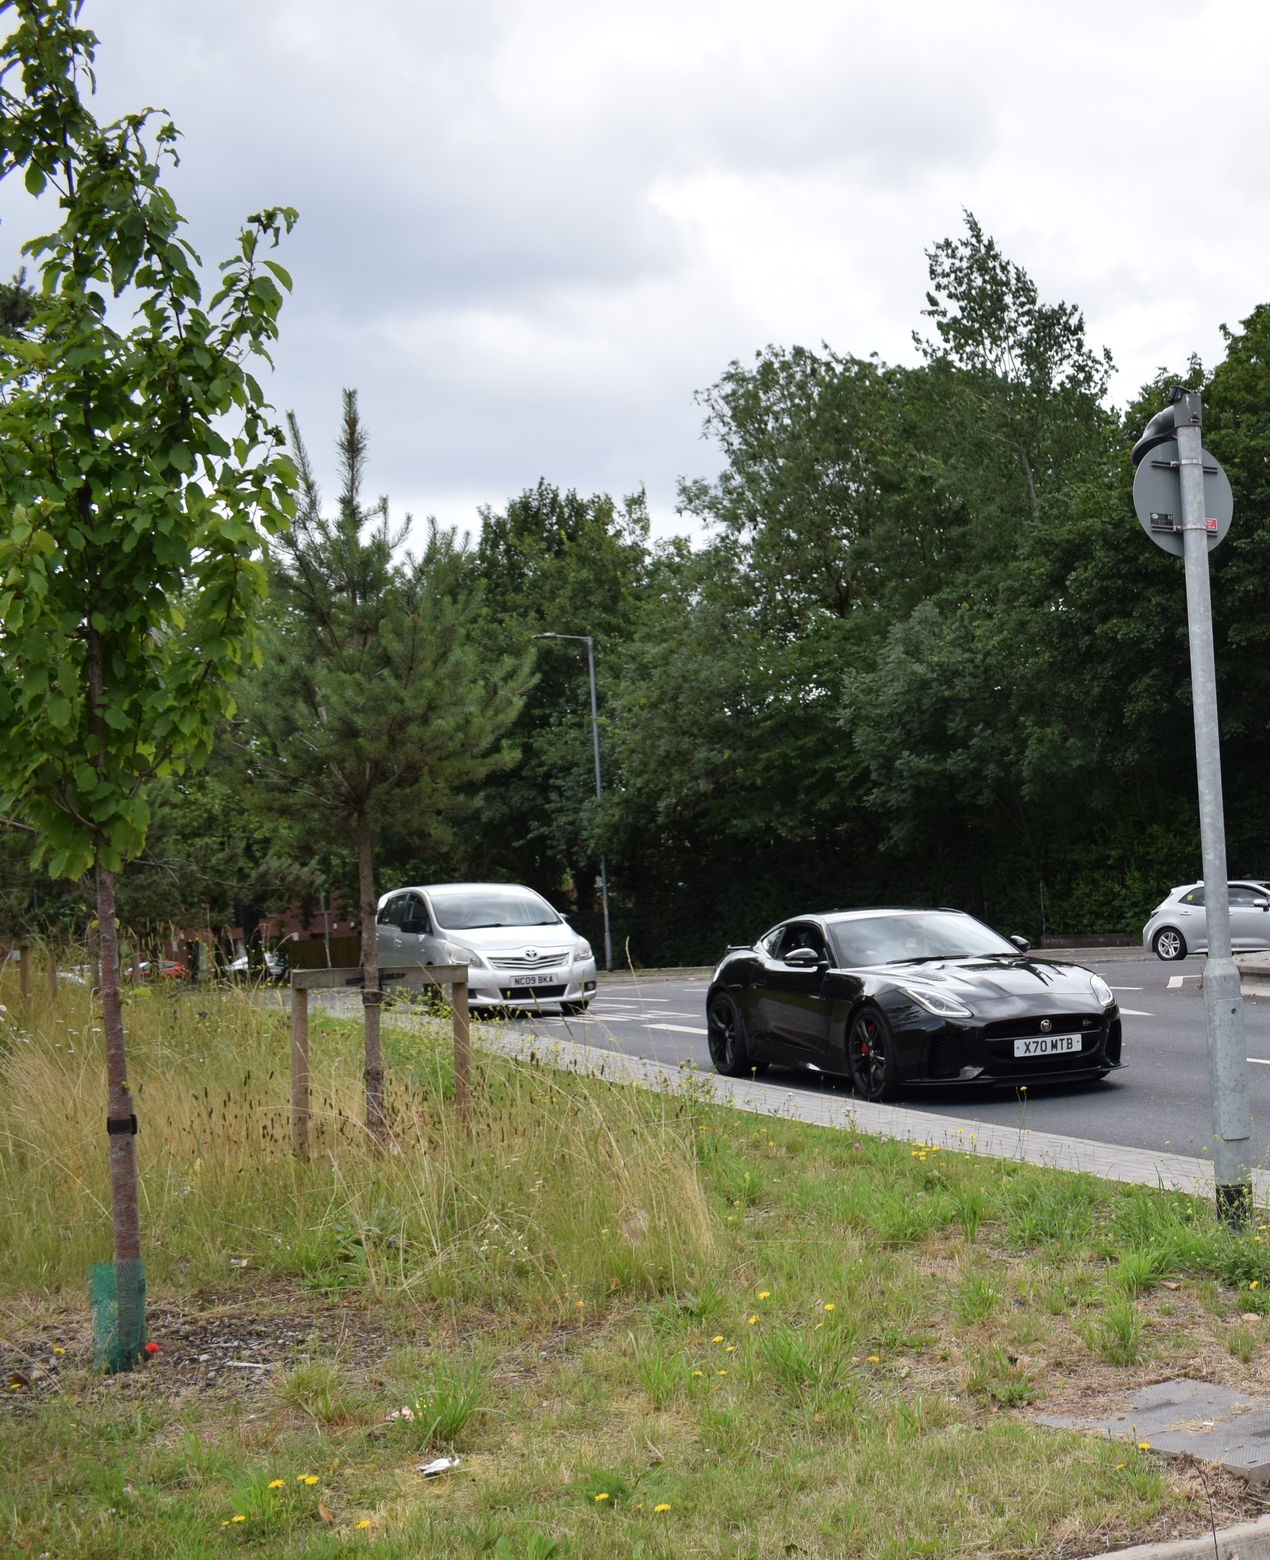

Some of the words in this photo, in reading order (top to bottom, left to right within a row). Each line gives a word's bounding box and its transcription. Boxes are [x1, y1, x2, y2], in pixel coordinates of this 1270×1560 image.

[514, 976, 536, 985] NC09
[538, 975, 553, 984] BKA
[1024, 1040, 1048, 1054] X70
[1051, 1037, 1073, 1051] MTB
